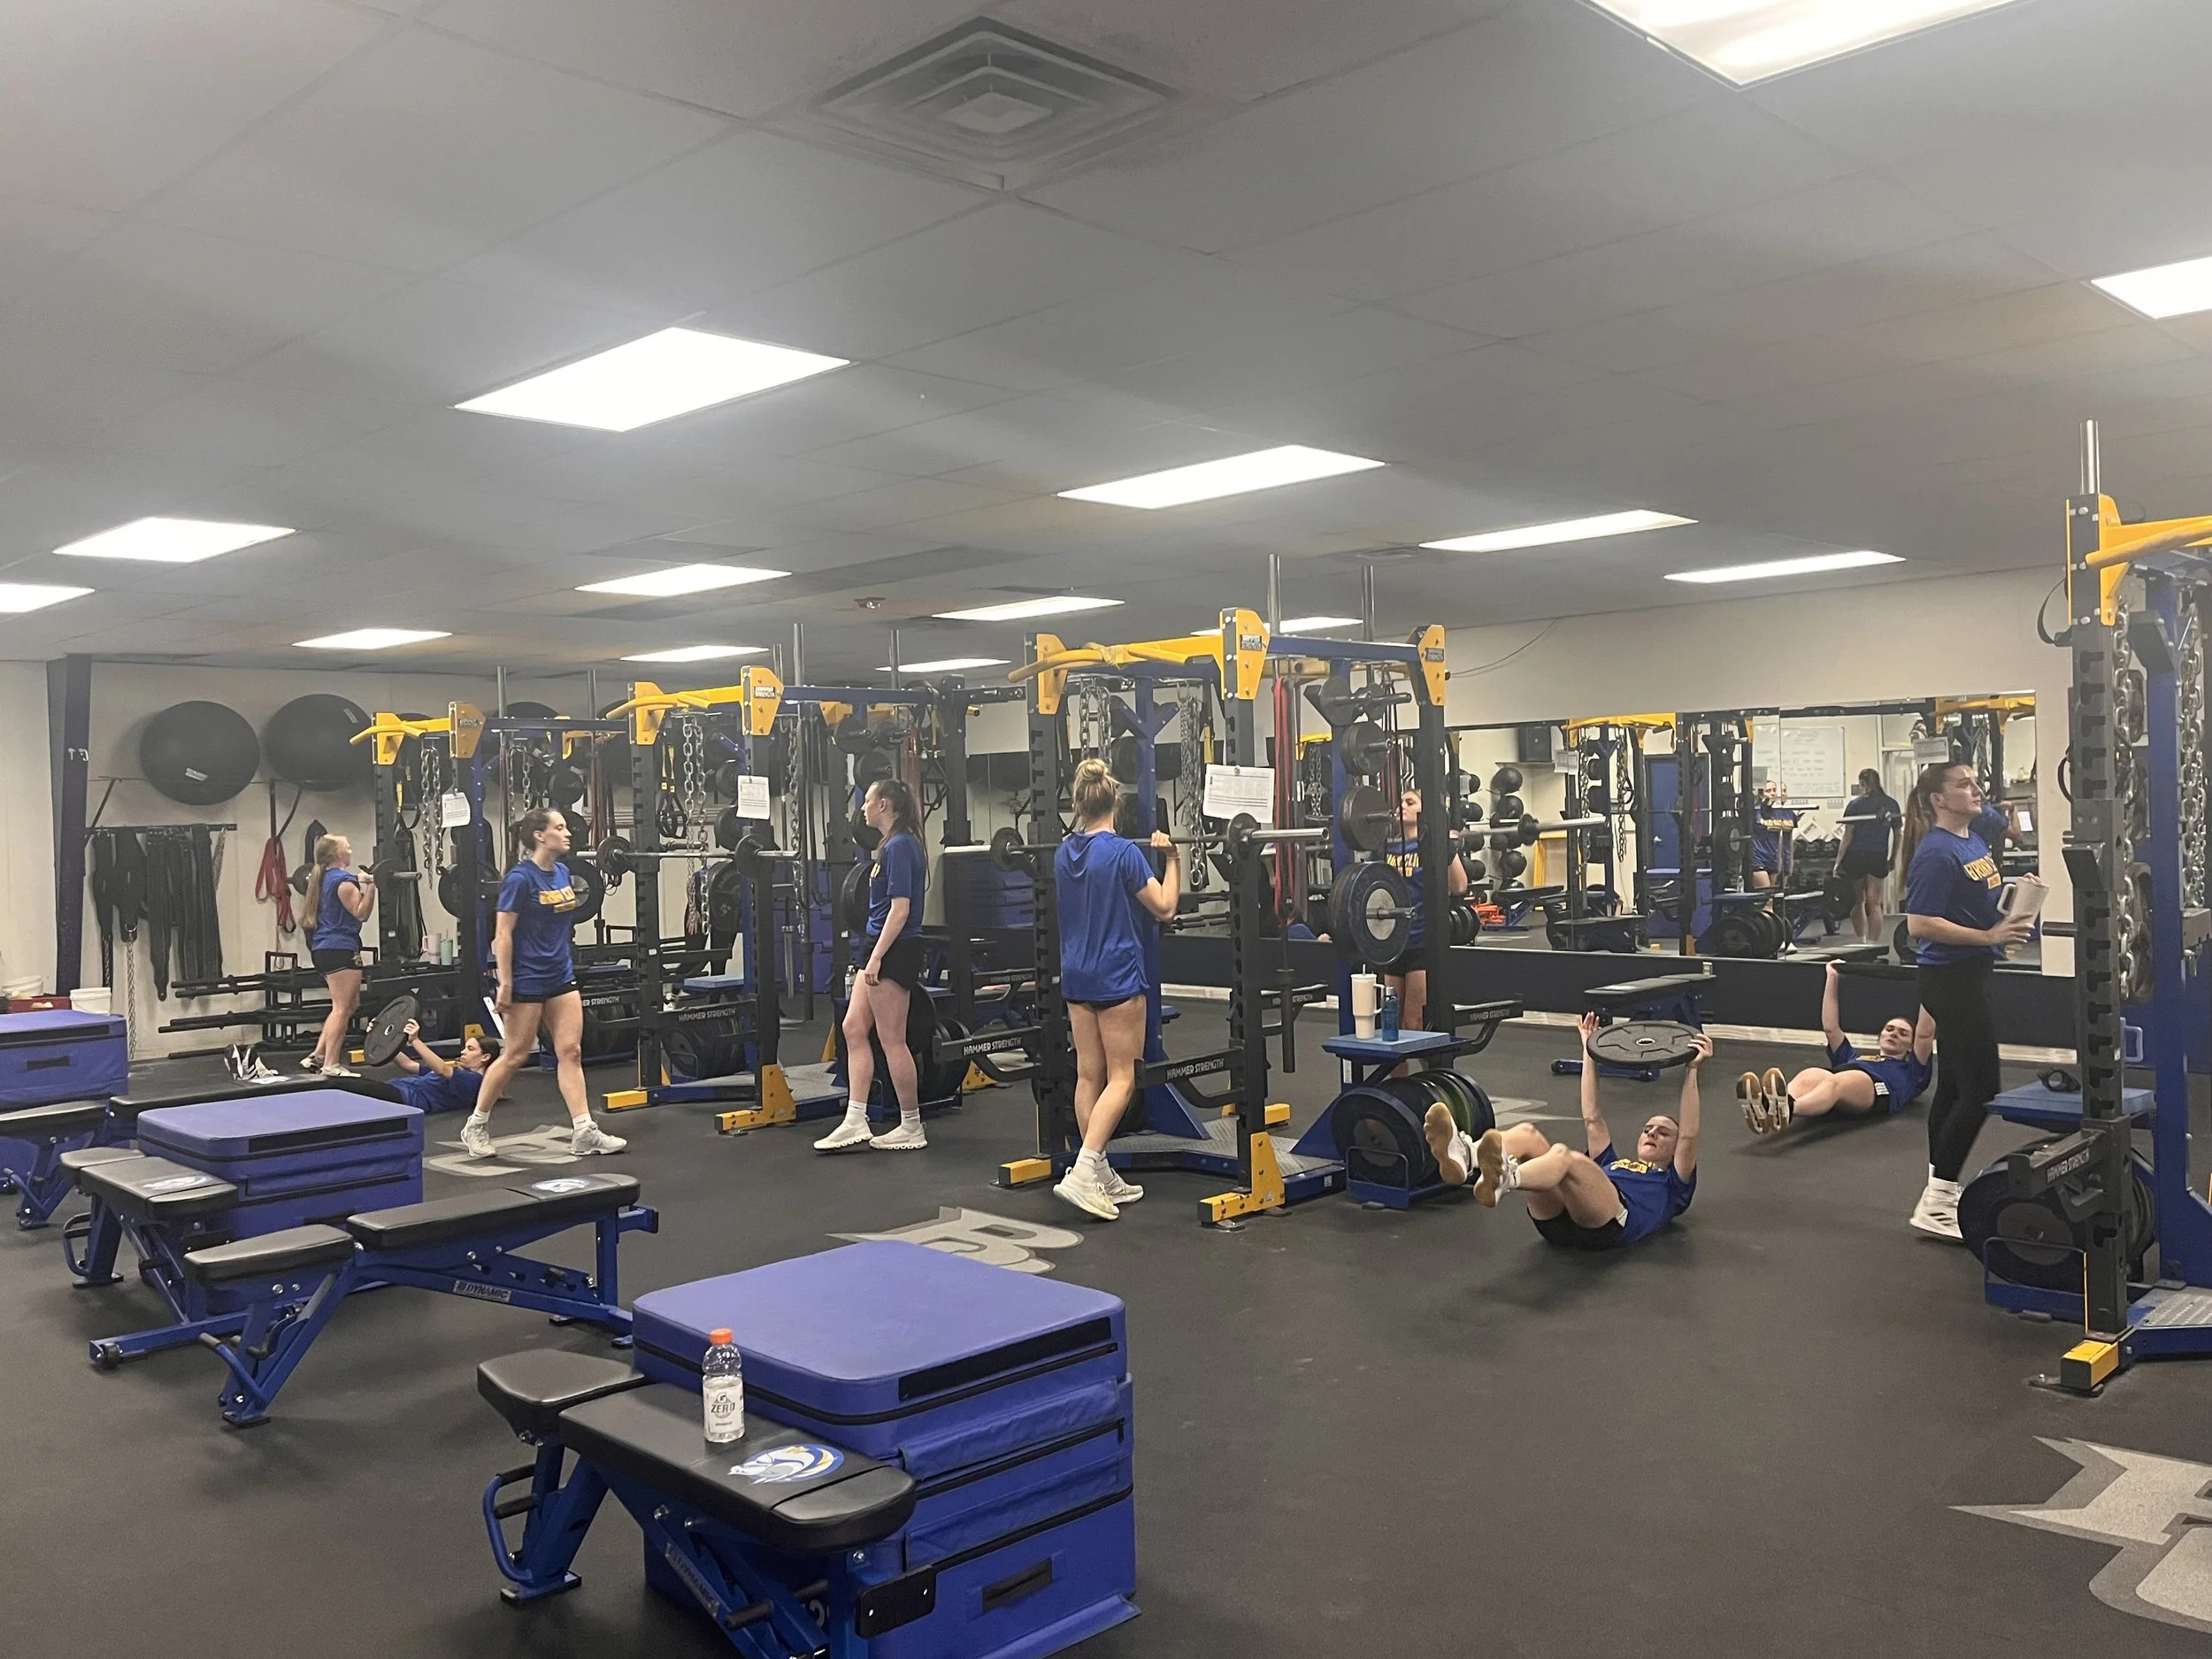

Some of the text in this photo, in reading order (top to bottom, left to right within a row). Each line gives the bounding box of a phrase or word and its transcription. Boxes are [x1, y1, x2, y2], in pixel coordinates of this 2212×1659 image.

[679, 1008, 736, 1022] HAMMER STRENGTH
[964, 1037, 1021, 1056] HAMMER STRENGTH
[1166, 1058, 1225, 1079] HAMMER STRENGTH
[466, 1283, 510, 1299] DYNAMIC
[710, 1402, 735, 1414] ZERO
